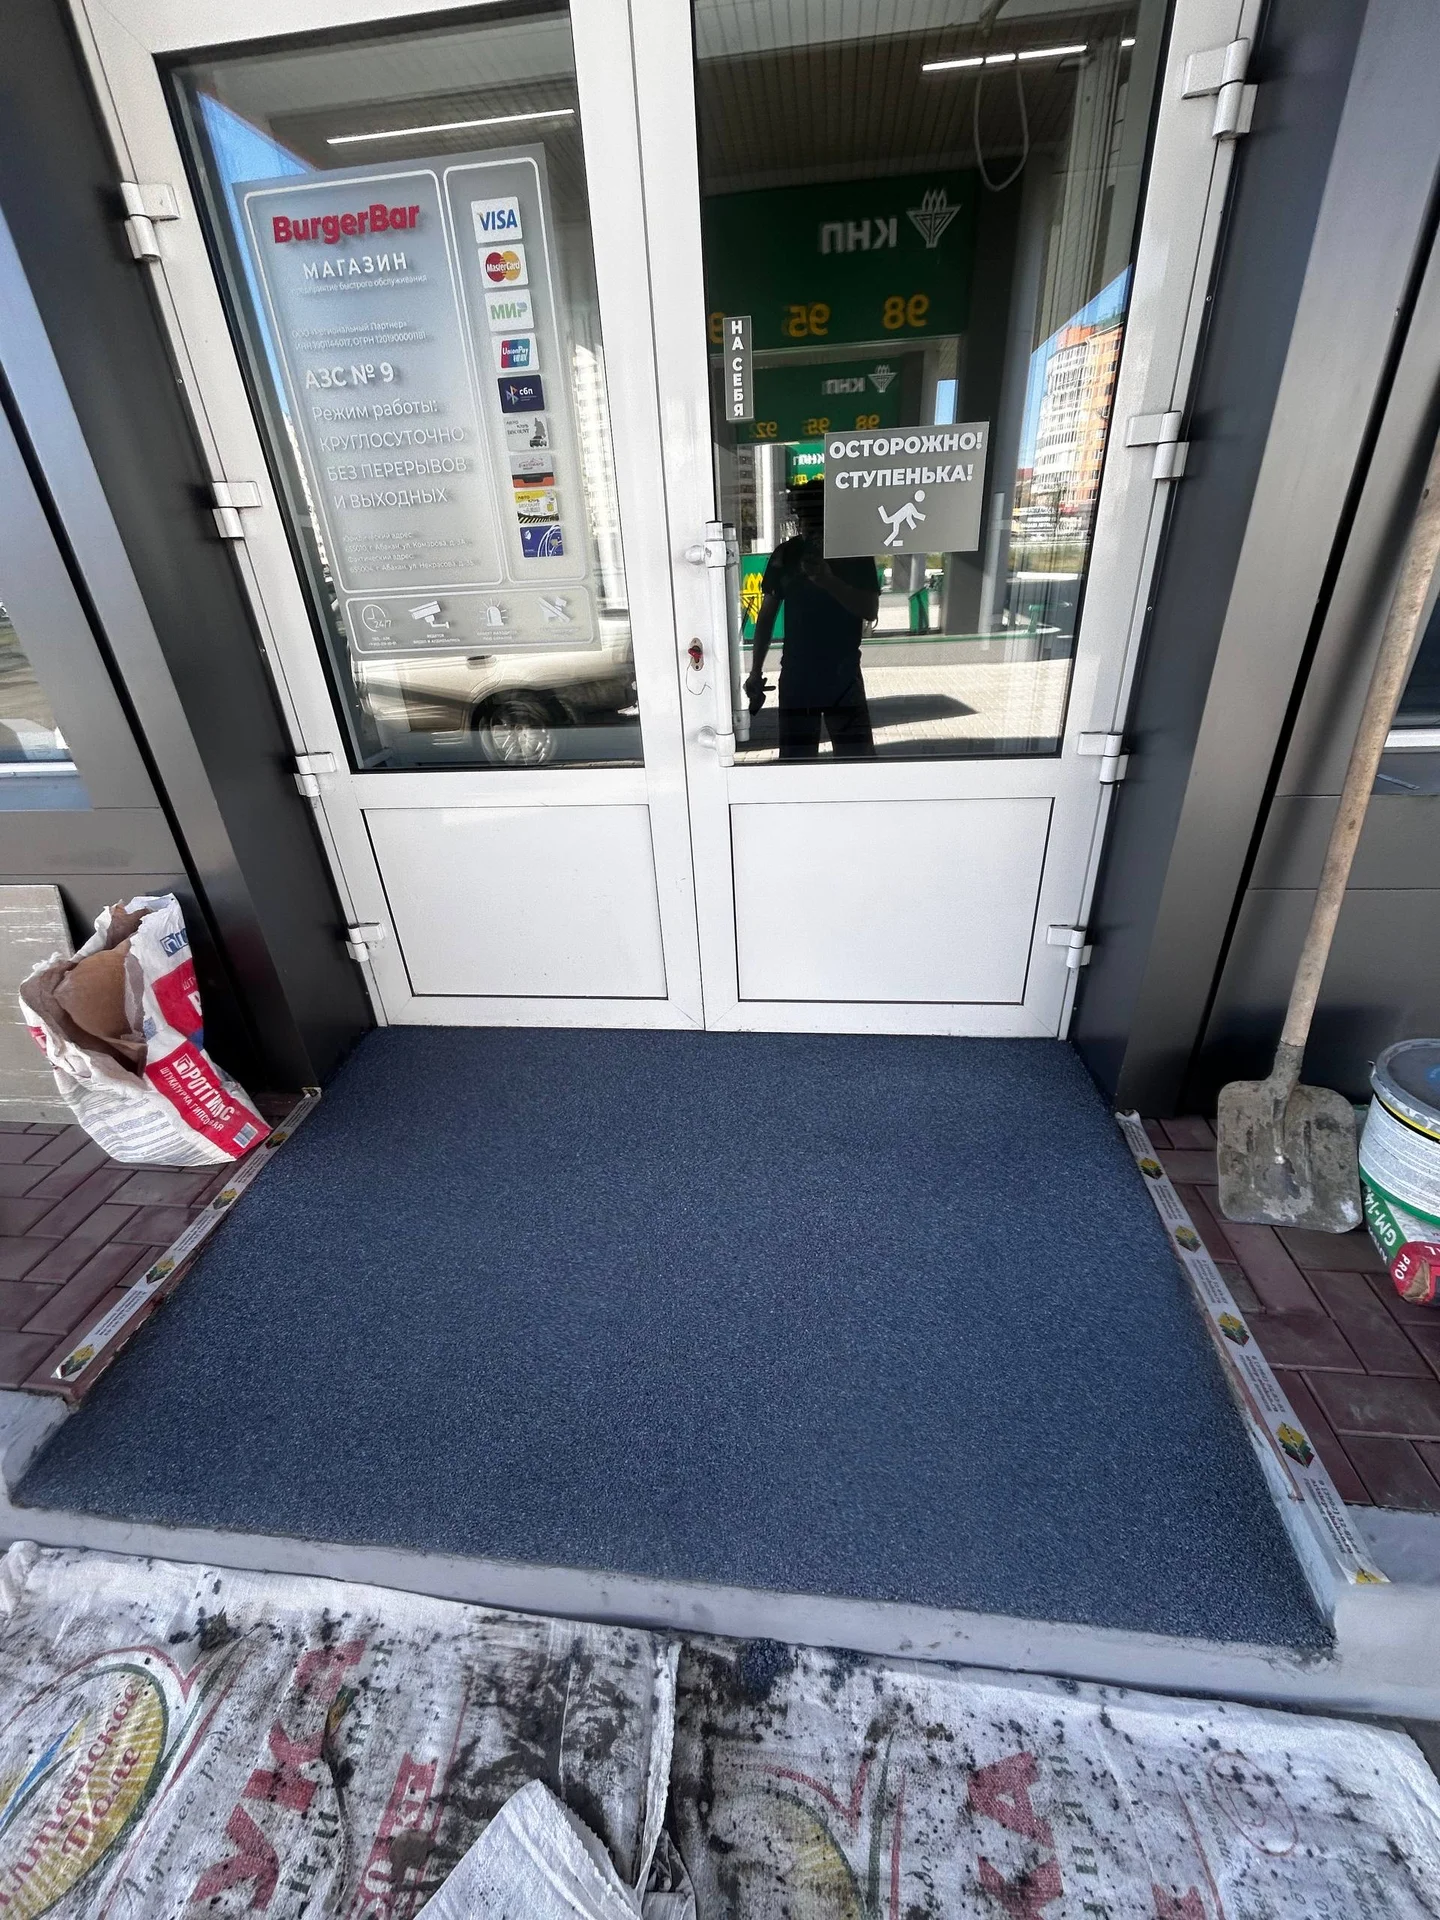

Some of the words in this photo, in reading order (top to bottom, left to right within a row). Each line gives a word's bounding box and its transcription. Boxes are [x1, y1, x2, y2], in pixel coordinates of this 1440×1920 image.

[272, 203, 420, 244] BurgerBar
[477, 209, 518, 231] VISA
[303, 252, 408, 280] МАГАЗИН
[486, 261, 520, 272] MasterCard
[490, 302, 528, 320] МИР
[732, 320, 744, 350] НА
[306, 366, 348, 389] АЗС
[350, 364, 376, 385] №
[380, 362, 394, 382] 9
[732, 357, 744, 416] СЕБЯ
[312, 404, 370, 421] Режим
[373, 398, 438, 420] работы:
[320, 426, 464, 452] КРУГЛОСУТОЧНО
[829, 432, 983, 460] ОСТОРОЖНО!
[326, 464, 358, 482] БЕЗ
[361, 457, 468, 478] ПЕРЕРЫВОВ
[835, 464, 974, 490] СТУПЕНЬКА!
[334, 495, 346, 510] И
[350, 488, 448, 508] ВЫХОДНЫХ
[374, 620, 392, 629] 24/7
[160, 1066, 194, 1110] ШТУКАТУРКА
[1394, 1254, 1411, 1280] PRO
[62, 1748, 140, 1855] Поле
